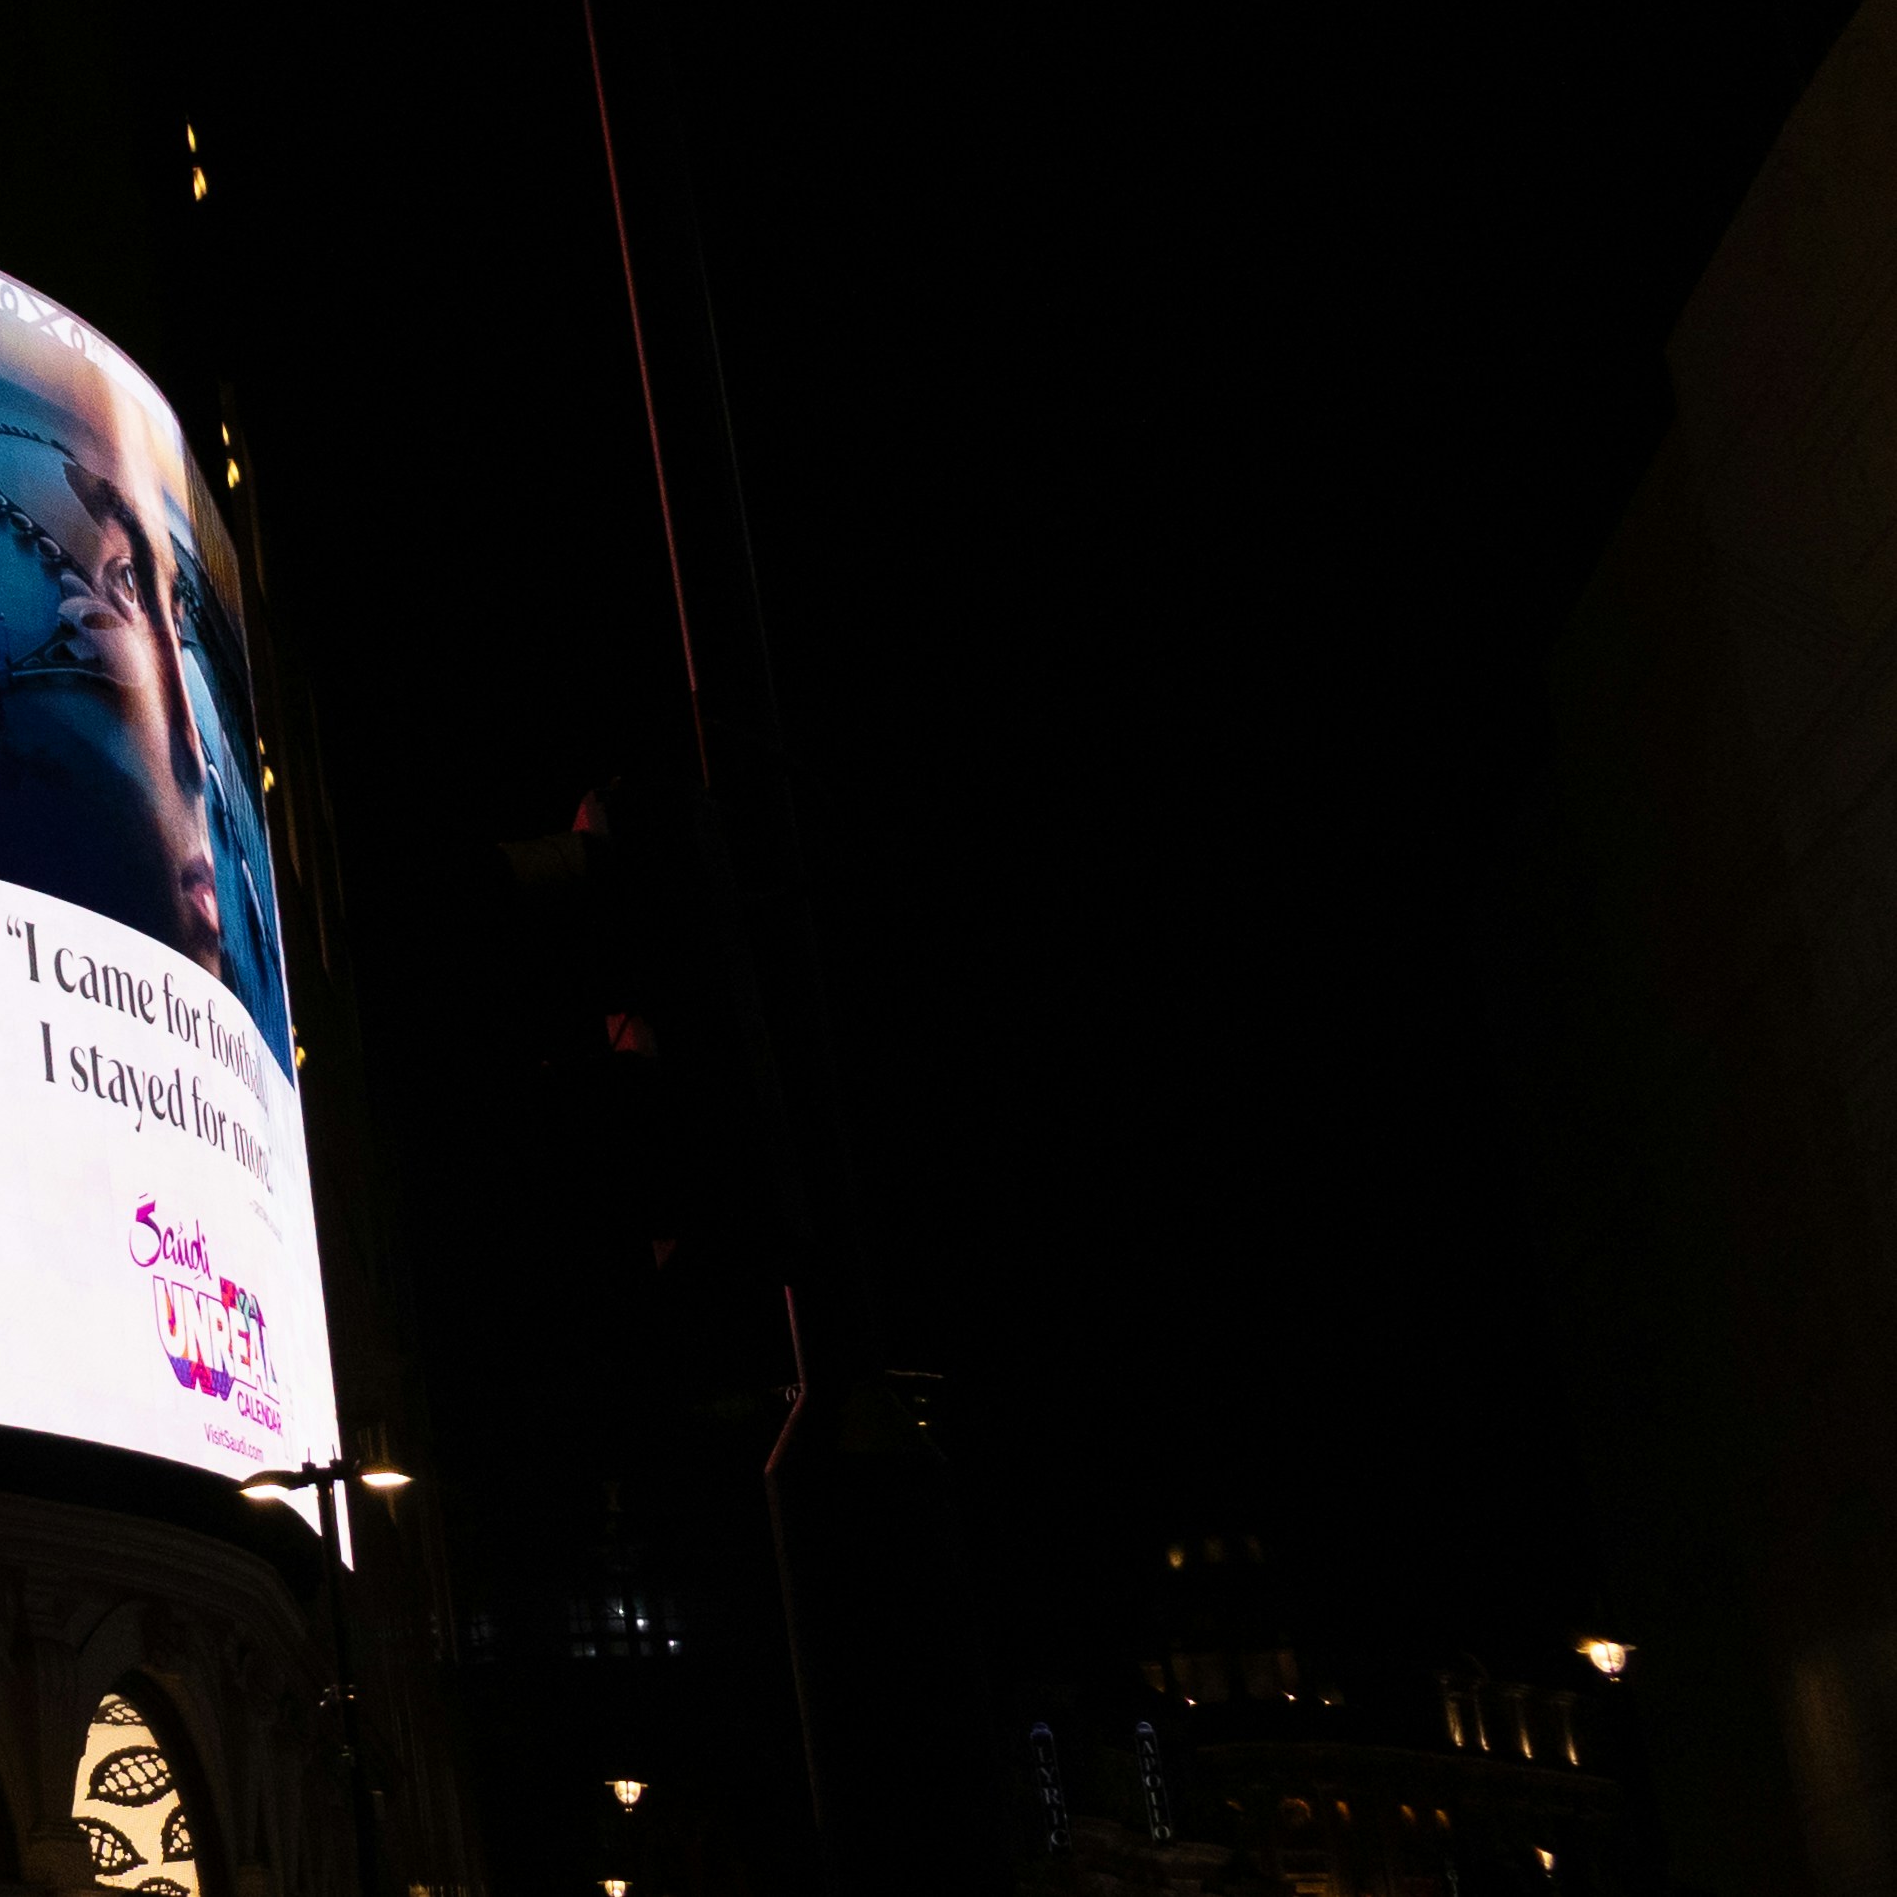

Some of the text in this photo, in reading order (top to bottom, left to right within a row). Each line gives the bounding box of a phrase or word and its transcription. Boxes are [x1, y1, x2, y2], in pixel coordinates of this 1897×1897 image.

[54, 947, 156, 1025] came
[162, 972, 201, 1050] for
[39, 1020, 56, 1084] I
[69, 1045, 187, 1133] stayed
[191, 1074, 227, 1152] for
[128, 1193, 212, 1281] Saudi
[152, 1275, 281, 1405] UNREAL
[203, 1422, 265, 1464] VisitSaudi.com
[236, 1389, 284, 1438] CALENDAR
[1037, 1745, 1069, 1847] LYRIC
